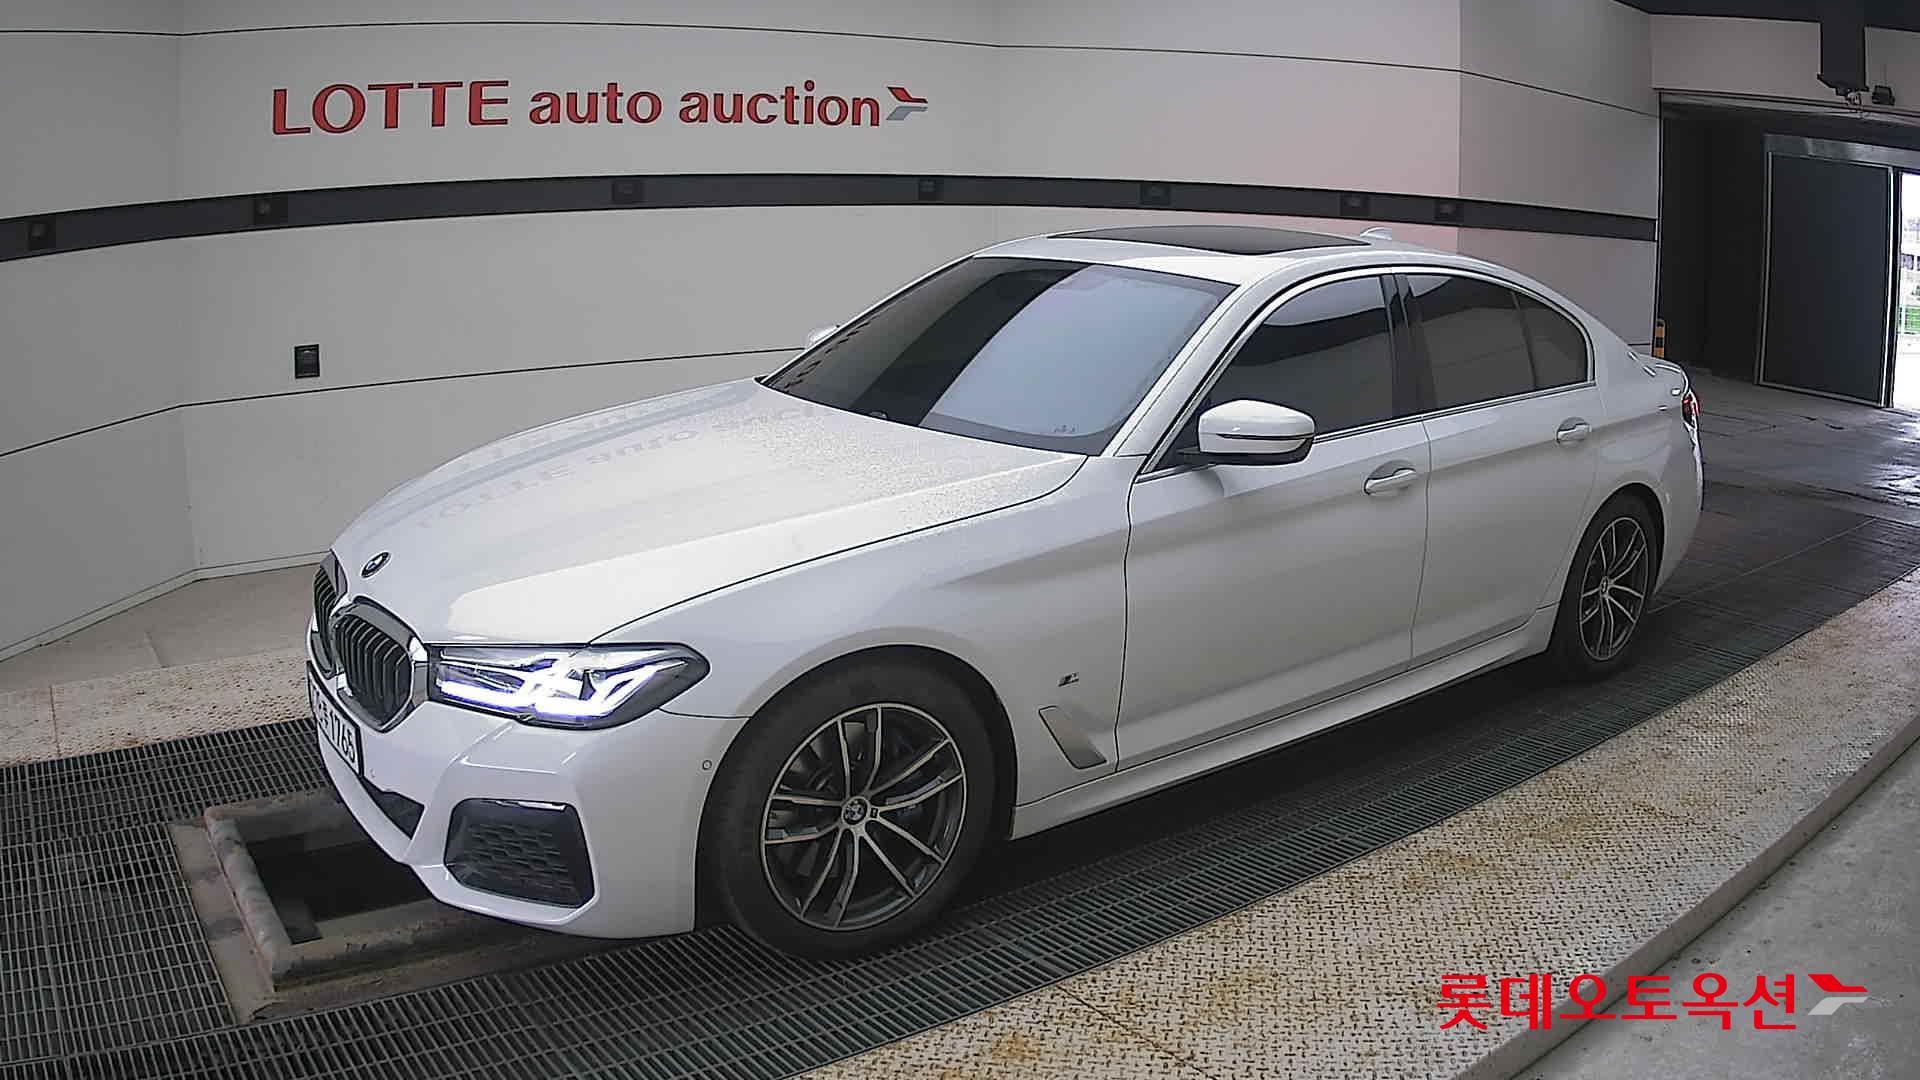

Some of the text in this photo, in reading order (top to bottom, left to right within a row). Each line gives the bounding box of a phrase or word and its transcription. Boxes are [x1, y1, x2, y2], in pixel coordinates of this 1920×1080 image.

[272, 80, 881, 135] LOTTE auto auction
